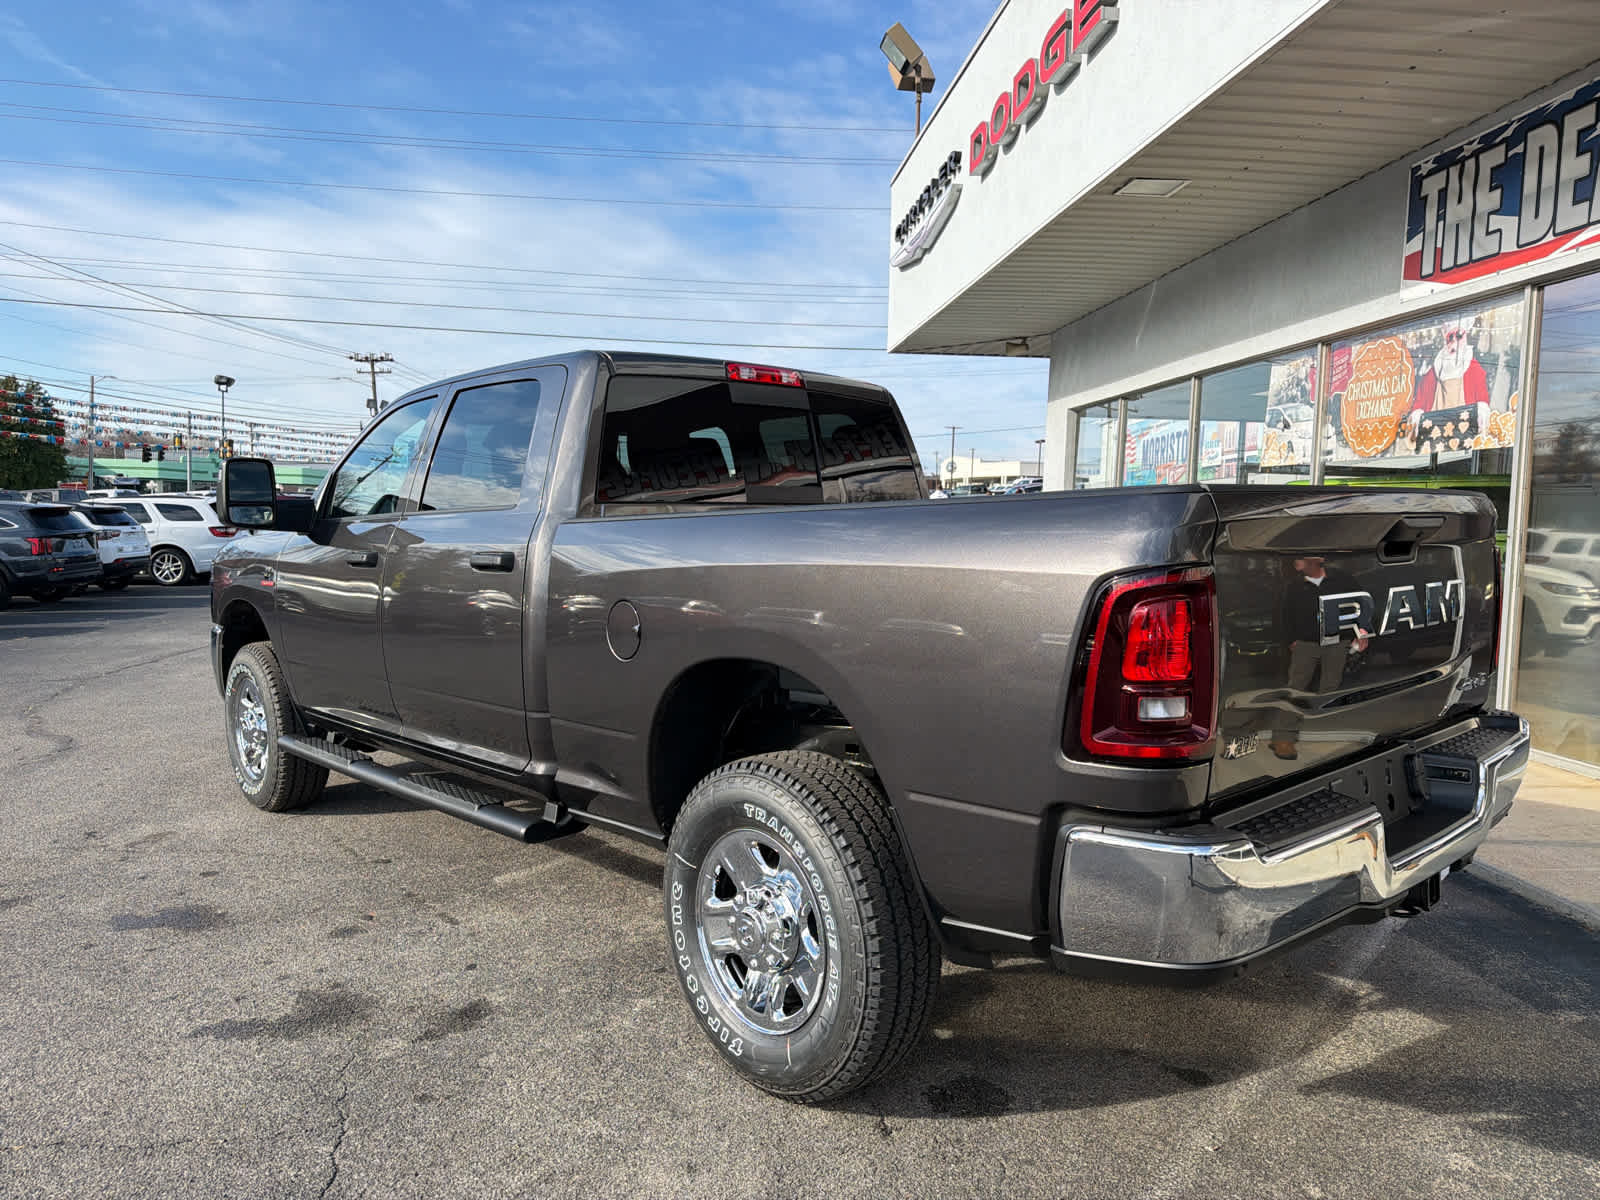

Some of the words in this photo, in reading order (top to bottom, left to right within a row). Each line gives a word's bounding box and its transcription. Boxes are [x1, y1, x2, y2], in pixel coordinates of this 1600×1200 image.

[970, 0, 1112, 177] DODGE
[1419, 142, 1509, 279] THE
[1348, 376, 1391, 402] CHRISTMAS
[1390, 373, 1407, 394] CAR
[1318, 579, 1464, 646] RAM
